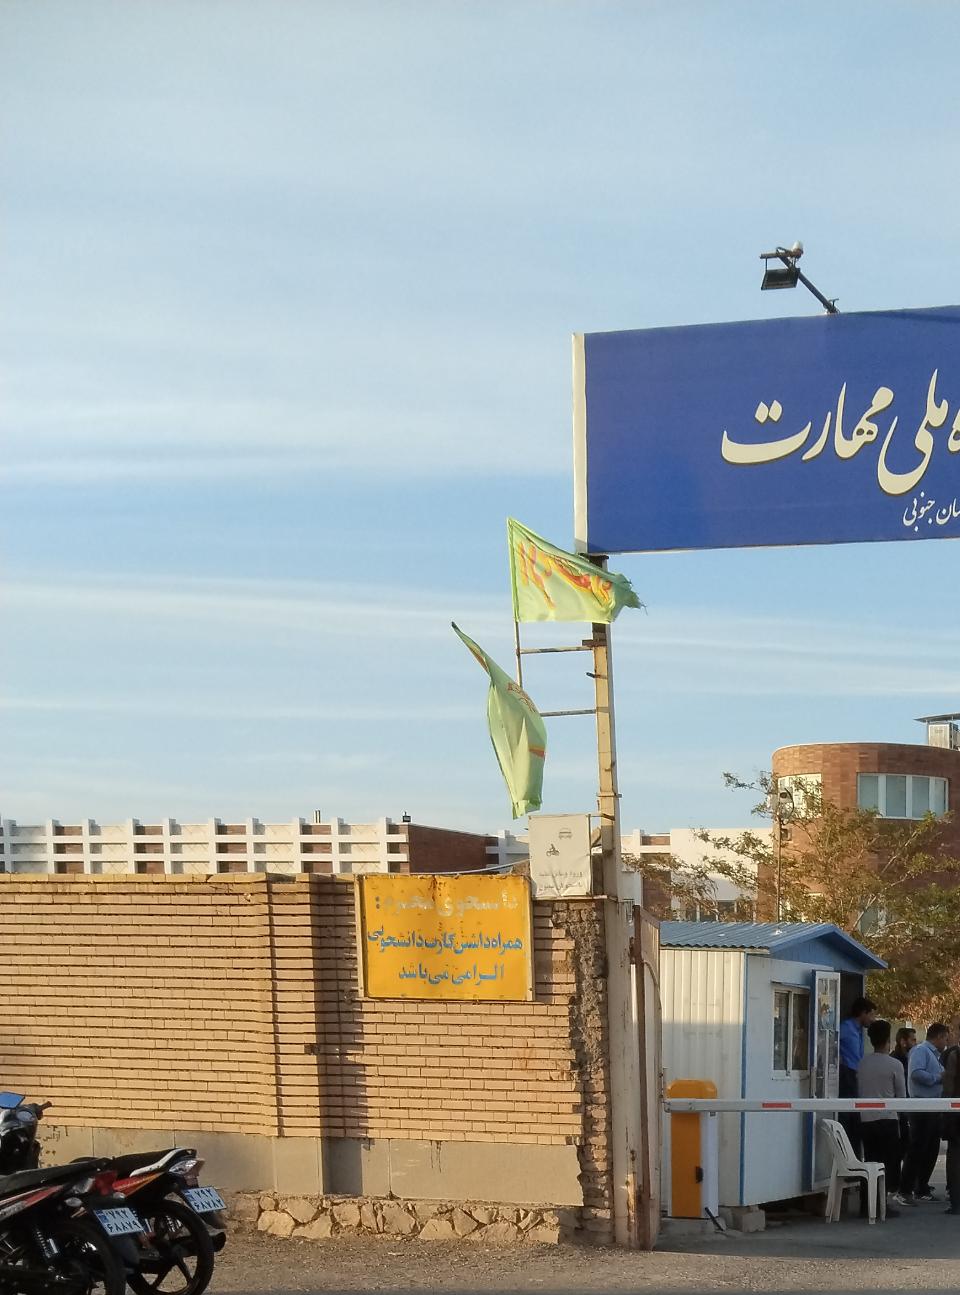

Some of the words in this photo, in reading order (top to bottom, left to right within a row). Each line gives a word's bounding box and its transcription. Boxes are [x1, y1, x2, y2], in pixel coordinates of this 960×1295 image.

[721, 382, 895, 465] مهارت
[878, 369, 949, 496] ملی
[902, 491, 936, 533] جنوبی
[491, 931, 524, 955] همراه
